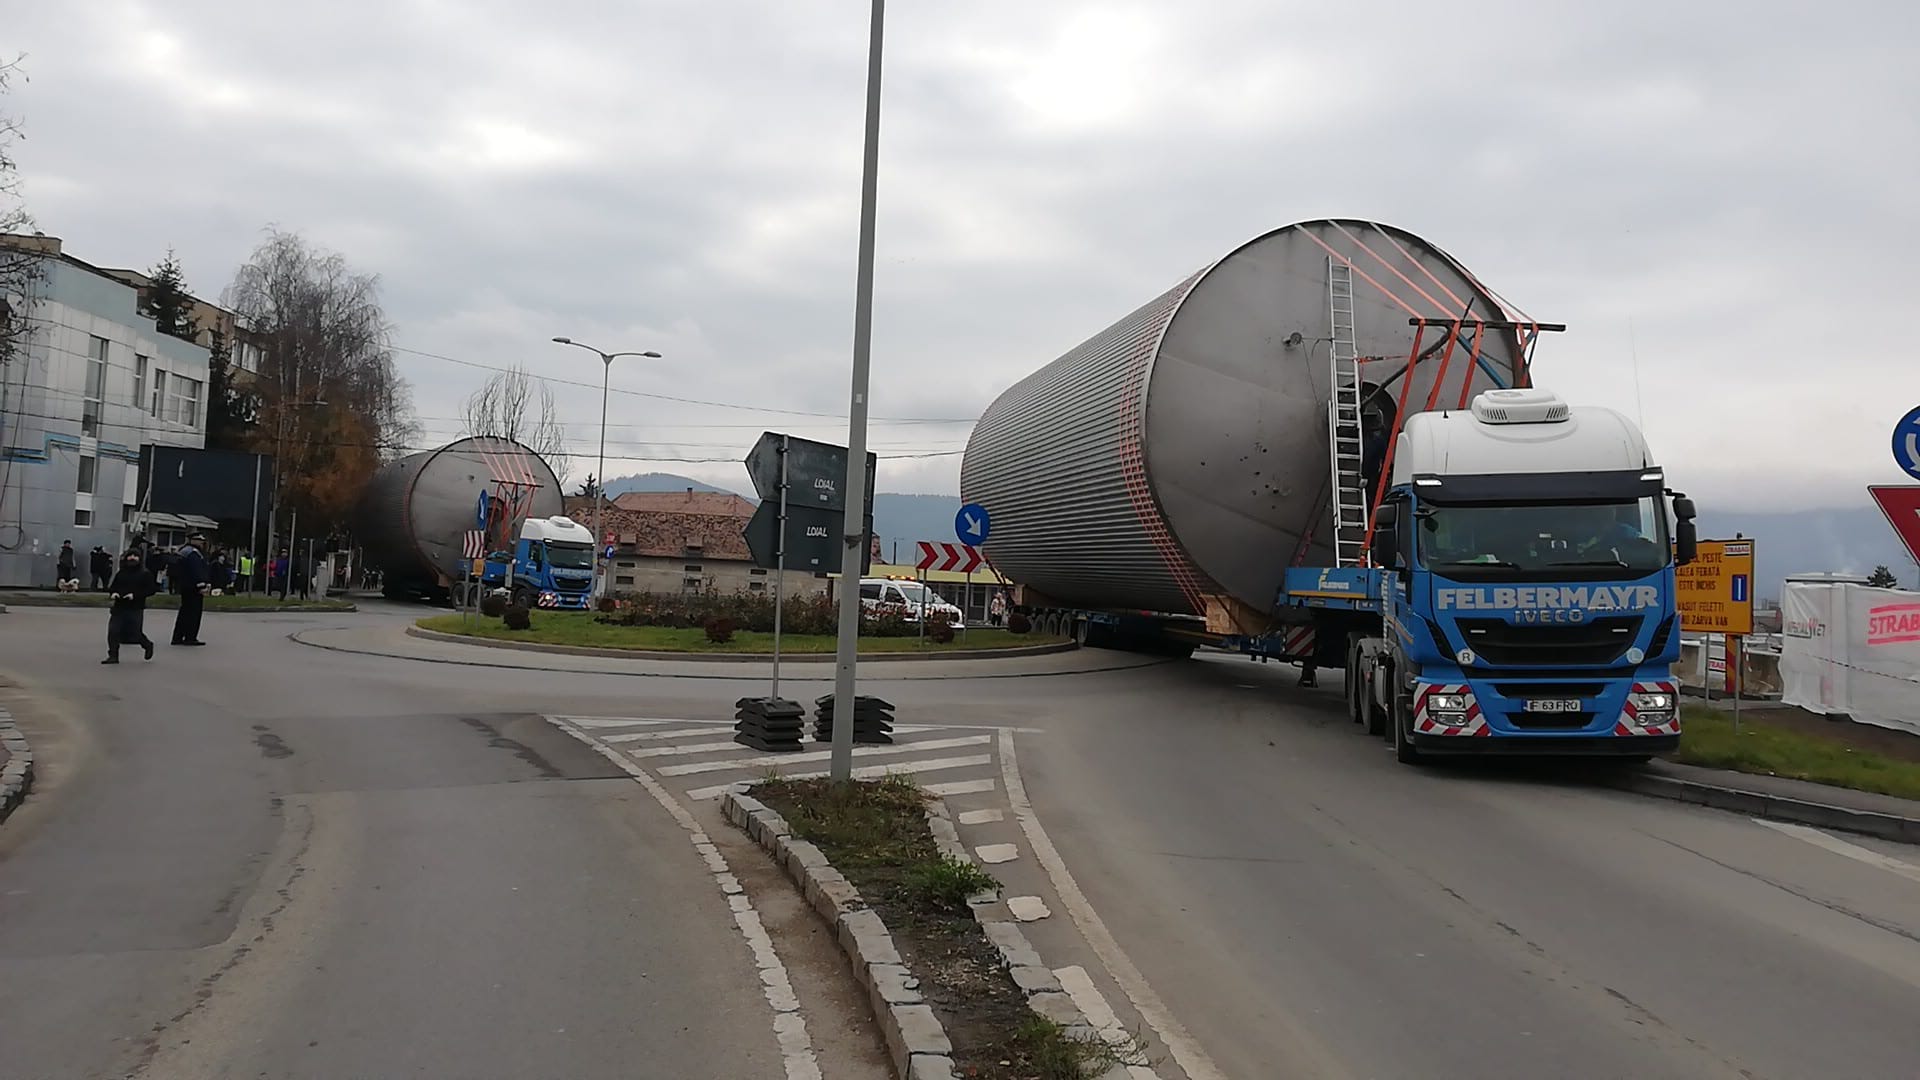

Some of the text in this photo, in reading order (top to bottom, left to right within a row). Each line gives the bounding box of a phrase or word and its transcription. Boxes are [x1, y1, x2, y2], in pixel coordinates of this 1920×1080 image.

[814, 478, 835, 491] LOIAL
[806, 526, 828, 537] LOIAL
[1703, 552, 1722, 563] PESTE
[1679, 580, 1694, 591] ESTE
[1438, 586, 1659, 609] FELBERMAYR
[1515, 608, 1584, 624] IVECO
[1462, 652, 1471, 662] R
[1542, 701, 1554, 712] 63
